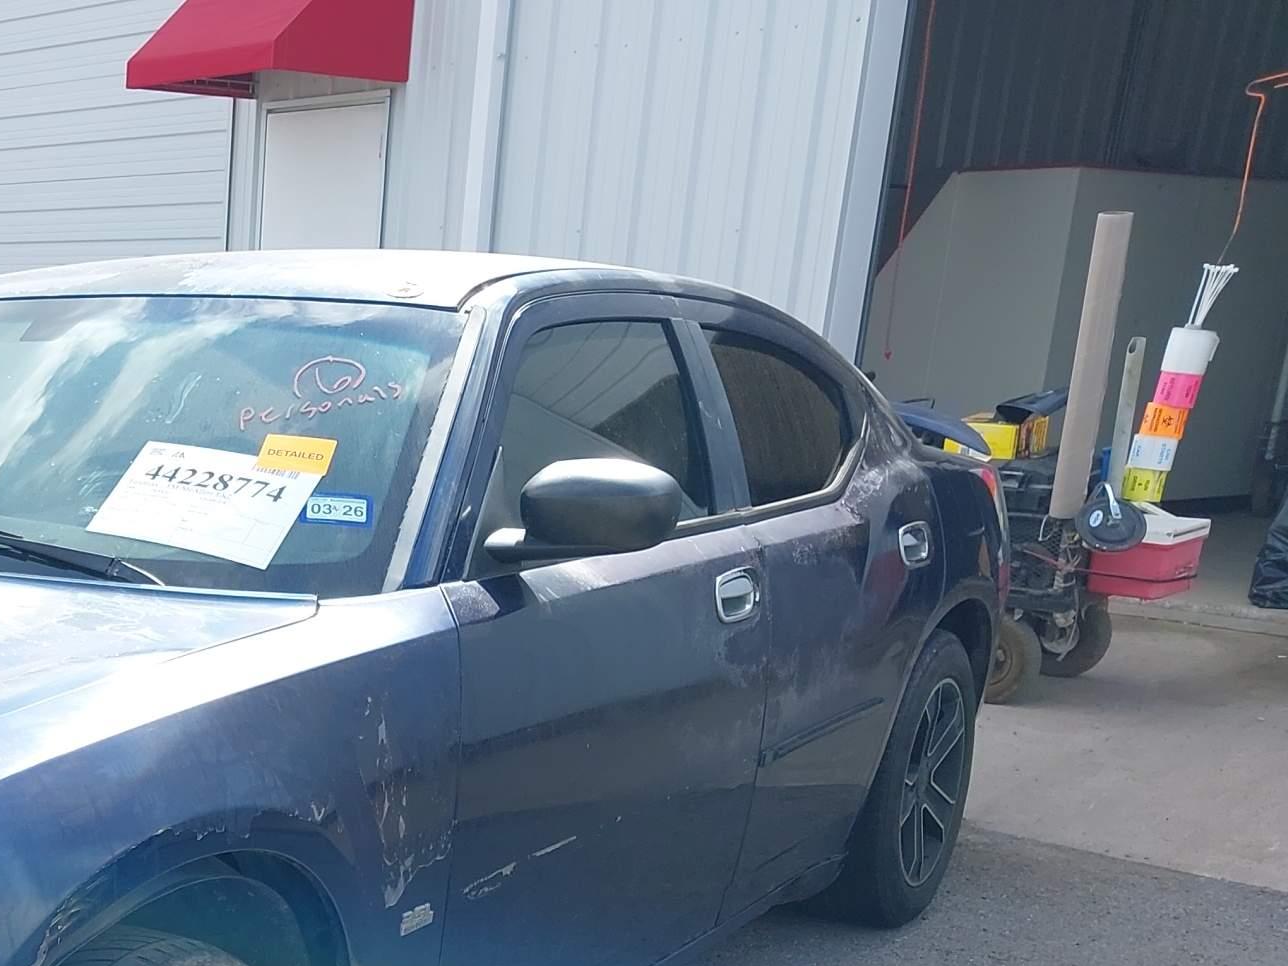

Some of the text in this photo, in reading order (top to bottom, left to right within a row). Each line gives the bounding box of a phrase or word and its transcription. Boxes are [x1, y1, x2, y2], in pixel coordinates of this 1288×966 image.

[267, 448, 324, 461] DETAILED
[144, 464, 288, 502] 44228774
[310, 503, 365, 518] 03 26
